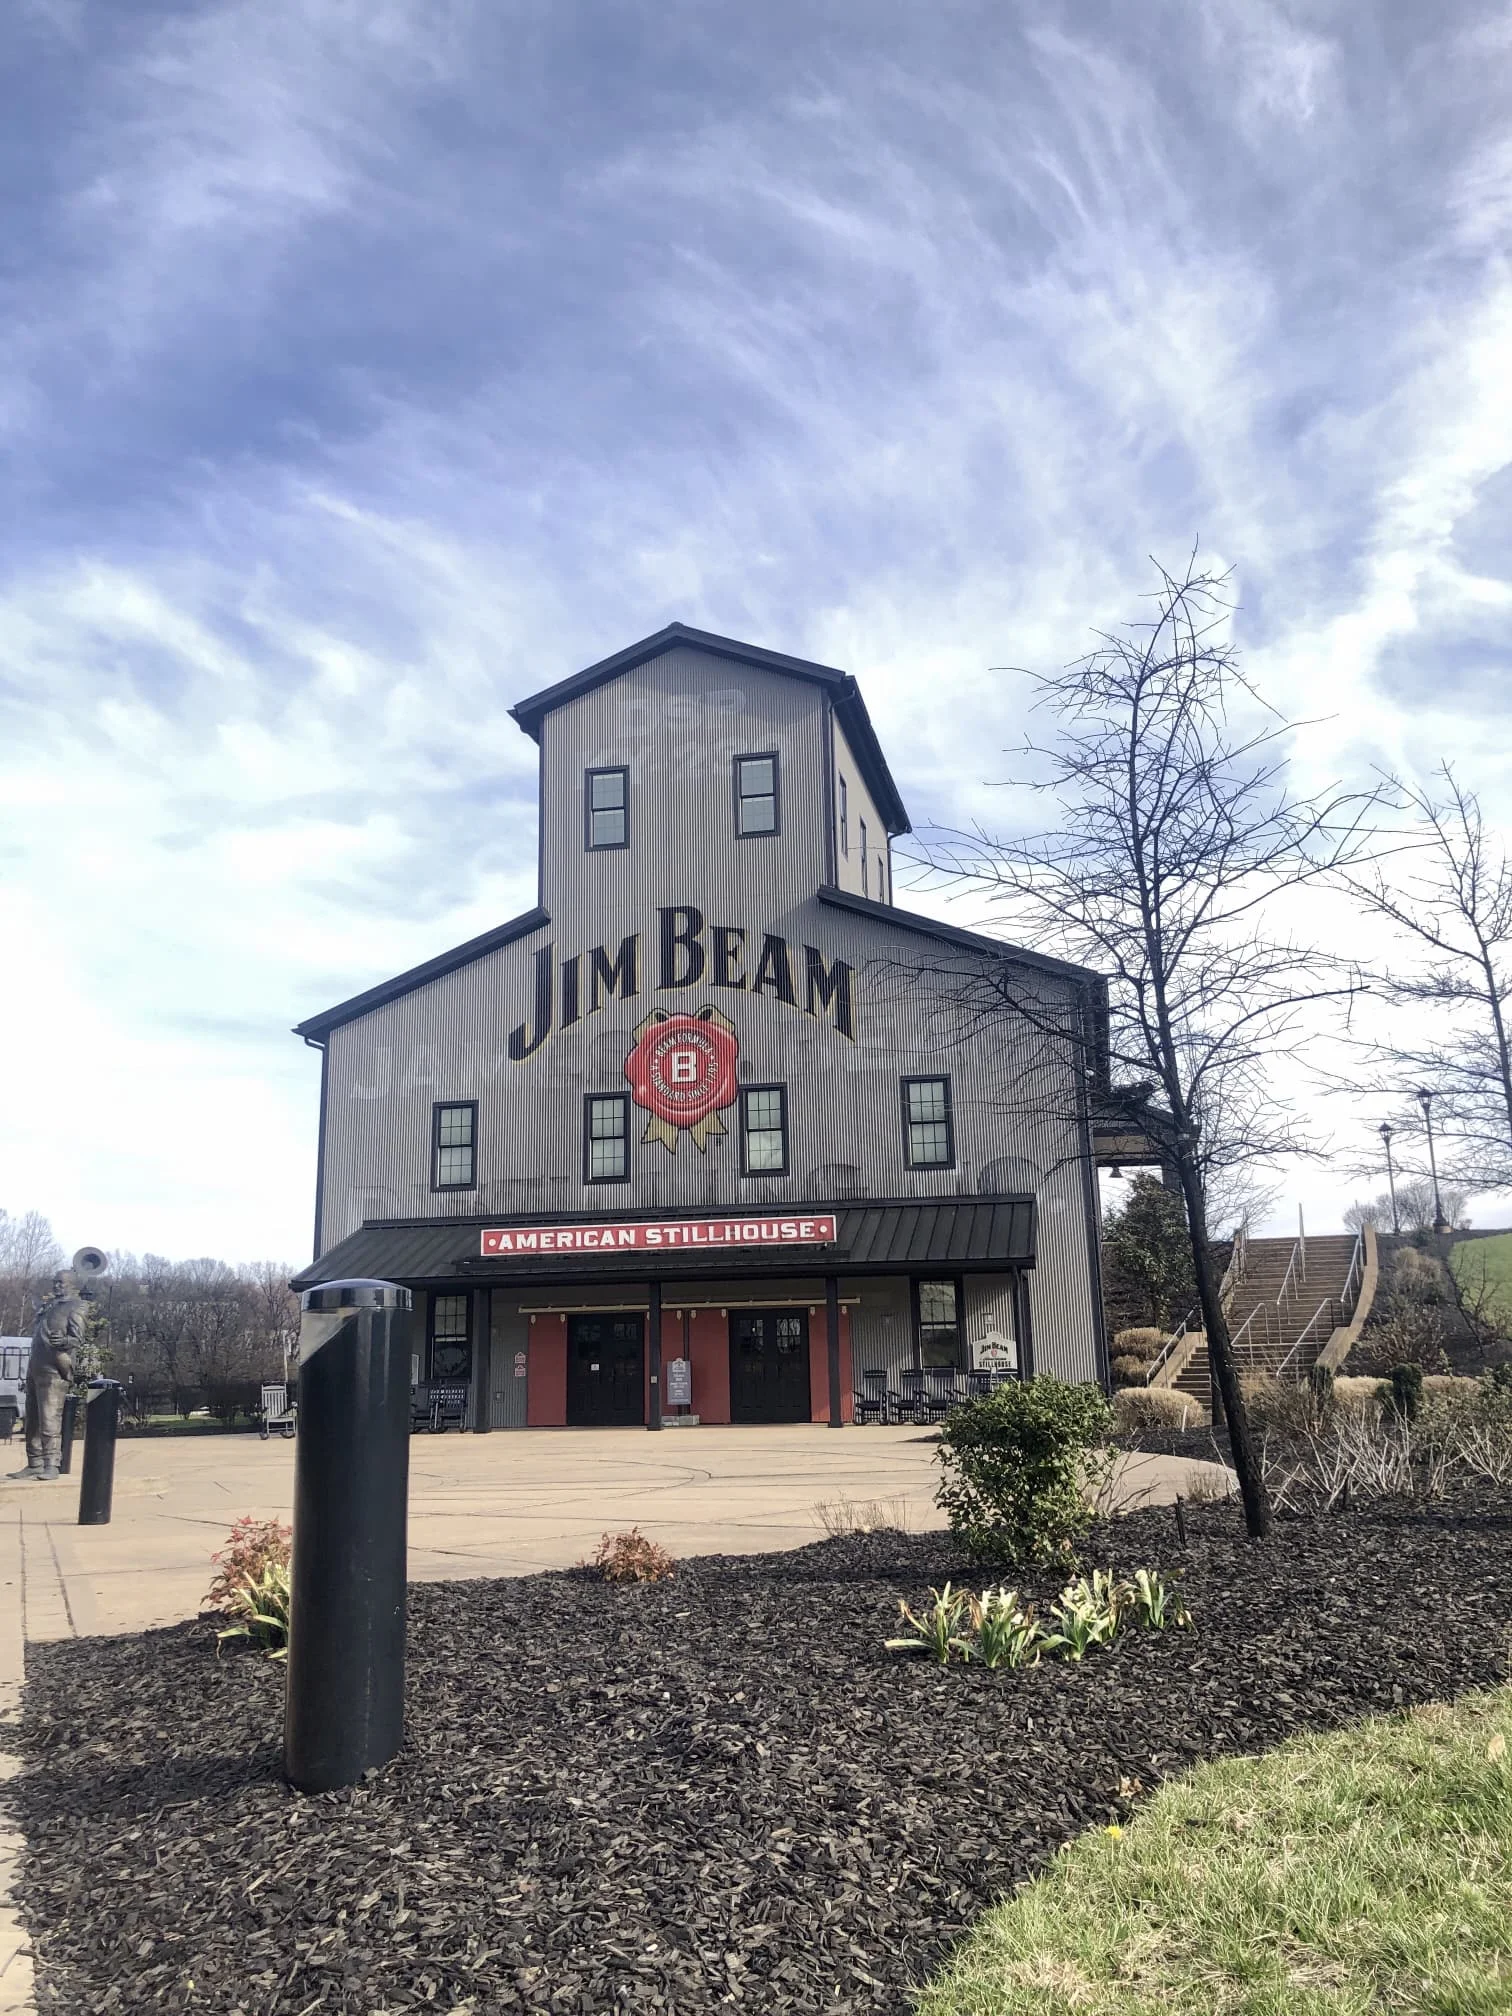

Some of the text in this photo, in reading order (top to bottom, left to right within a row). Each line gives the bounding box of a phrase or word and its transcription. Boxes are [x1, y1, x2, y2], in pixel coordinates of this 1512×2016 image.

[507, 931, 643, 1064] JIM
[654, 905, 857, 1045] BEAM
[656, 1032, 713, 1056] BEAM FORMULA
[671, 1051, 697, 1083] B
[652, 1071, 685, 1101] STANDARD
[497, 1221, 816, 1251] AMERICAN STILLHOUSE
[980, 1341, 1008, 1354] JIM BEAM
